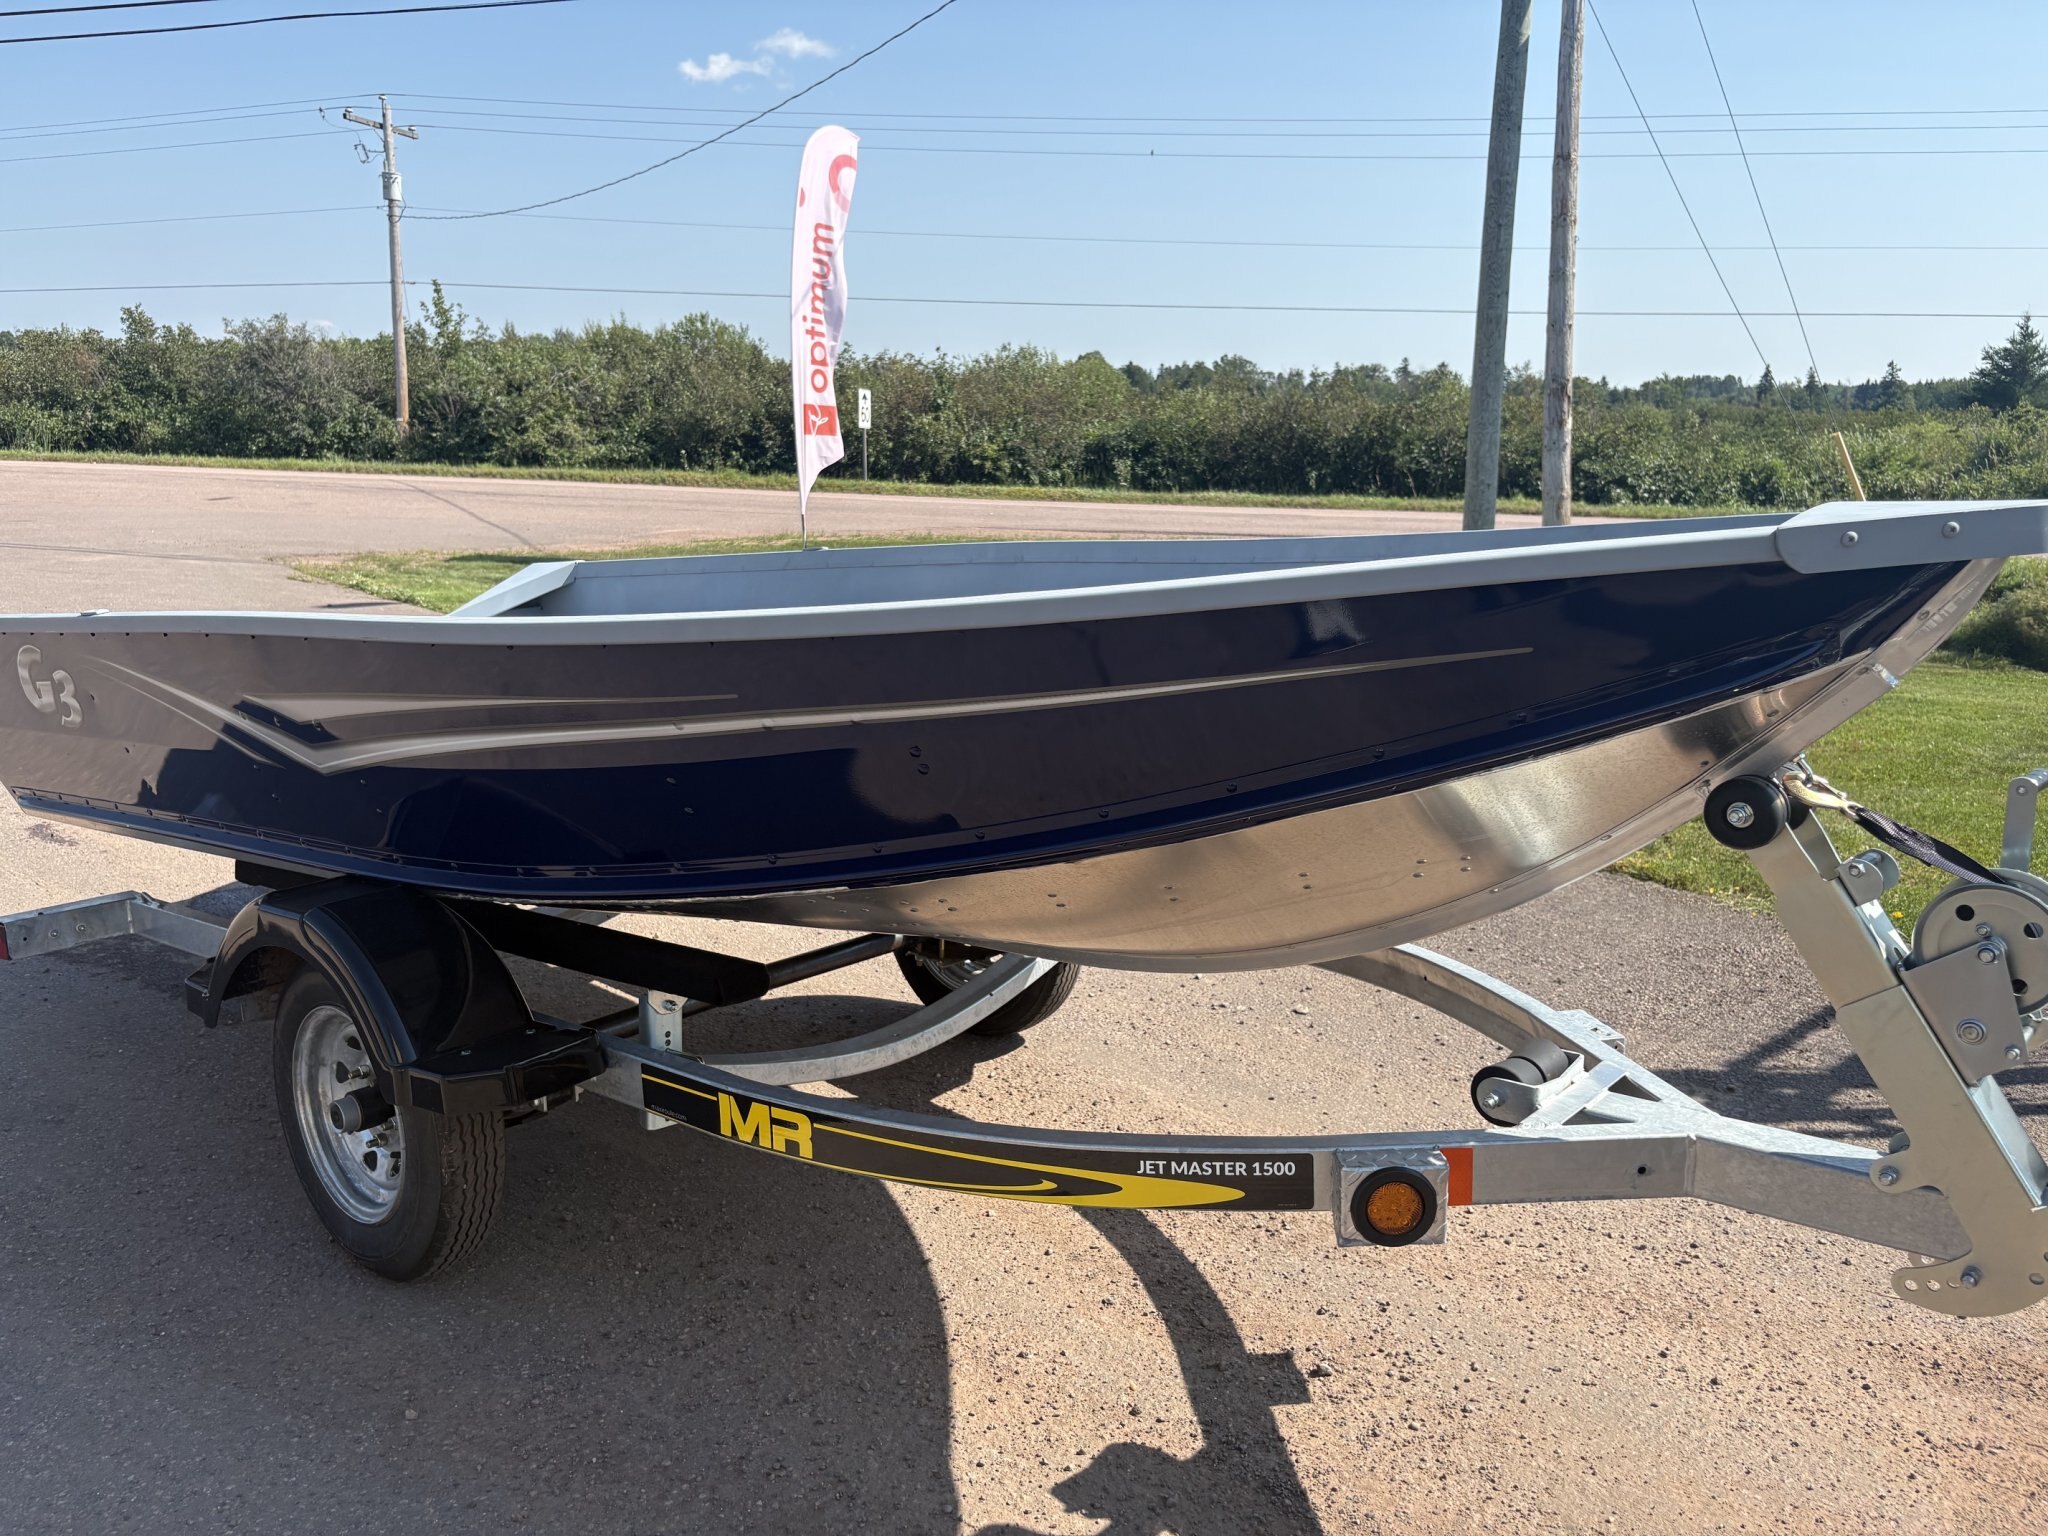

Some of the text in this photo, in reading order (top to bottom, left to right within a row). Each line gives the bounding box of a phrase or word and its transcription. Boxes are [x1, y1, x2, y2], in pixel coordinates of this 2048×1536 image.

[802, 222, 834, 394] optimum
[17, 644, 83, 728] G3
[718, 1092, 813, 1160] MR
[1137, 1160, 1296, 1176] JET MASTER 1500
